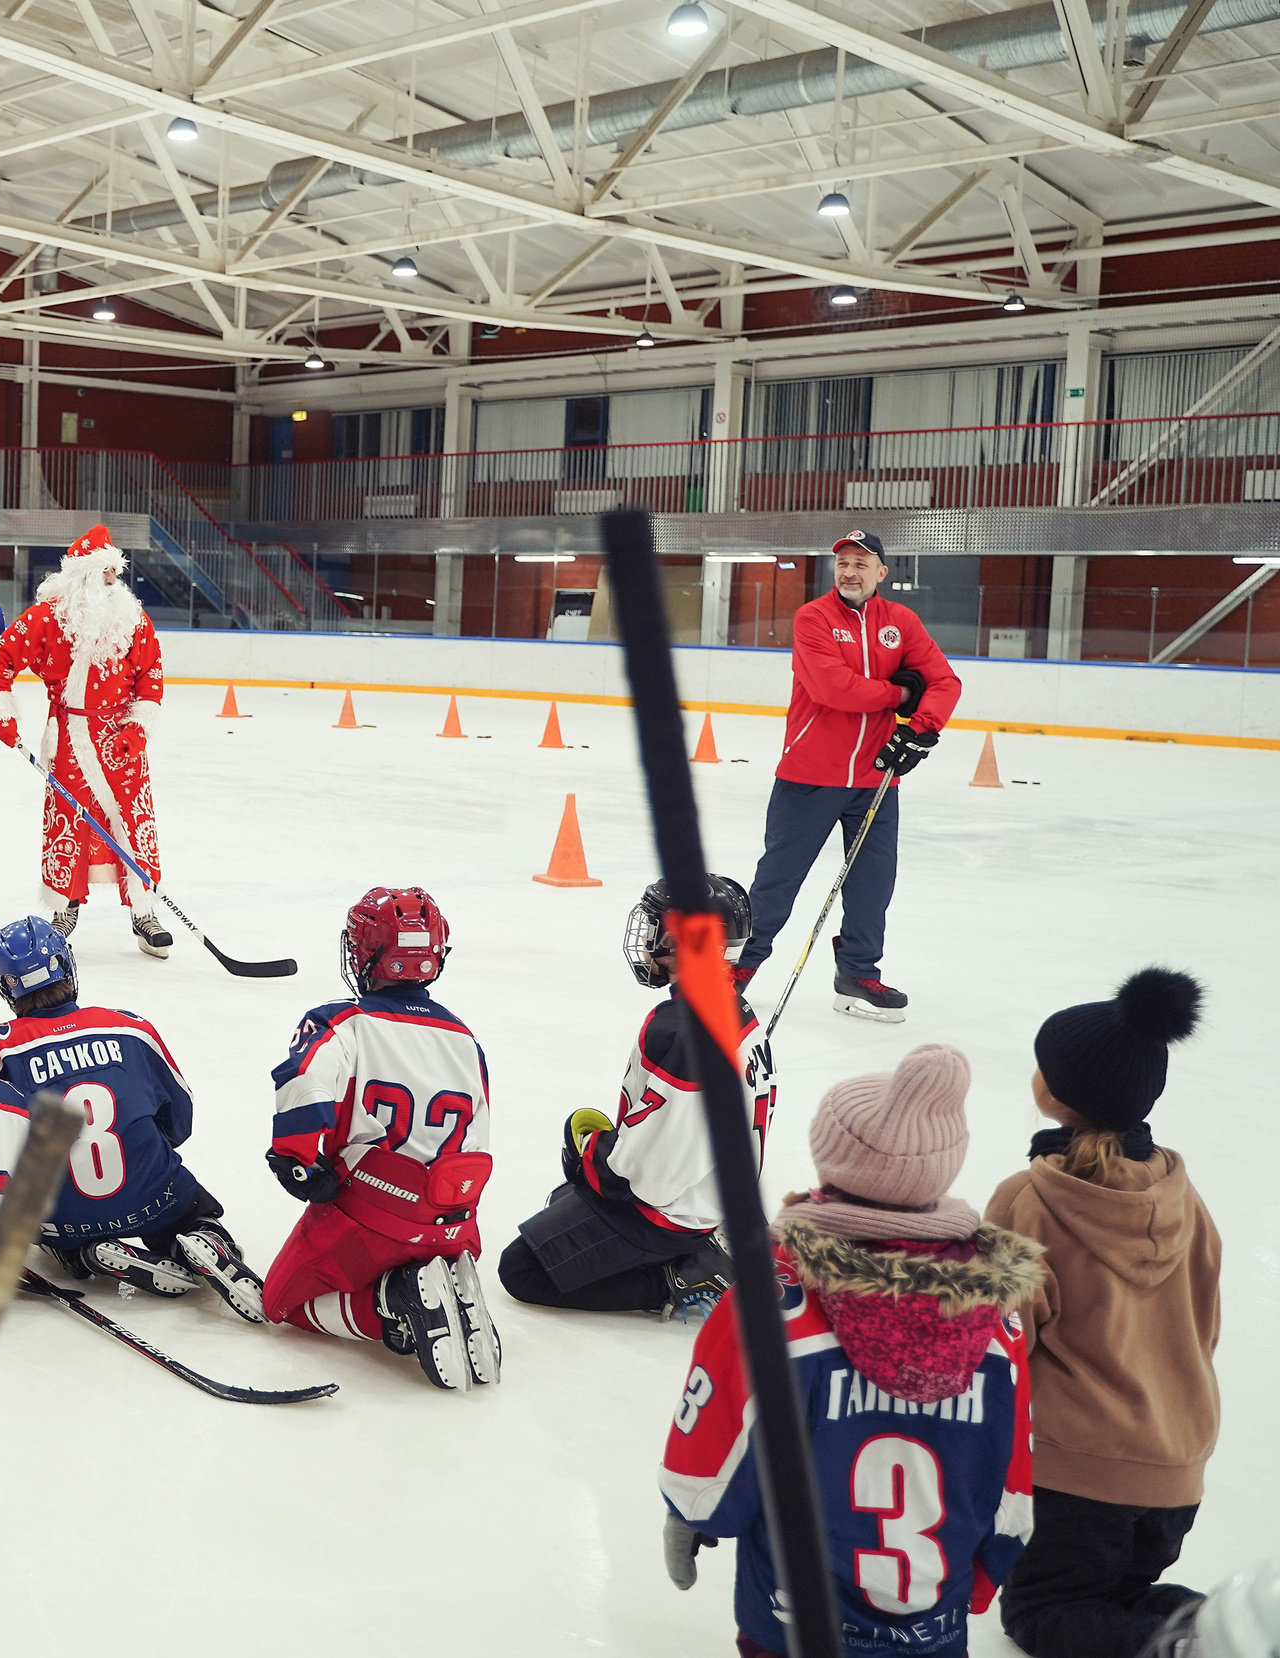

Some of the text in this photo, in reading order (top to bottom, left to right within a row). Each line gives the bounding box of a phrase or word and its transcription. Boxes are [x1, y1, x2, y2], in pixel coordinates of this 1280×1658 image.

[160, 894, 198, 932] NORDWAY
[52, 1023, 76, 1032] LUTCH
[406, 1005, 431, 1013] LUTCH
[28, 1039, 123, 1084] САЧКОВ
[63, 1081, 126, 1199] 8
[353, 1168, 420, 1204] WARRIOR
[63, 1187, 175, 1233] SPINETIX
[673, 1365, 714, 1435] 3
[849, 1432, 948, 1615] 3
